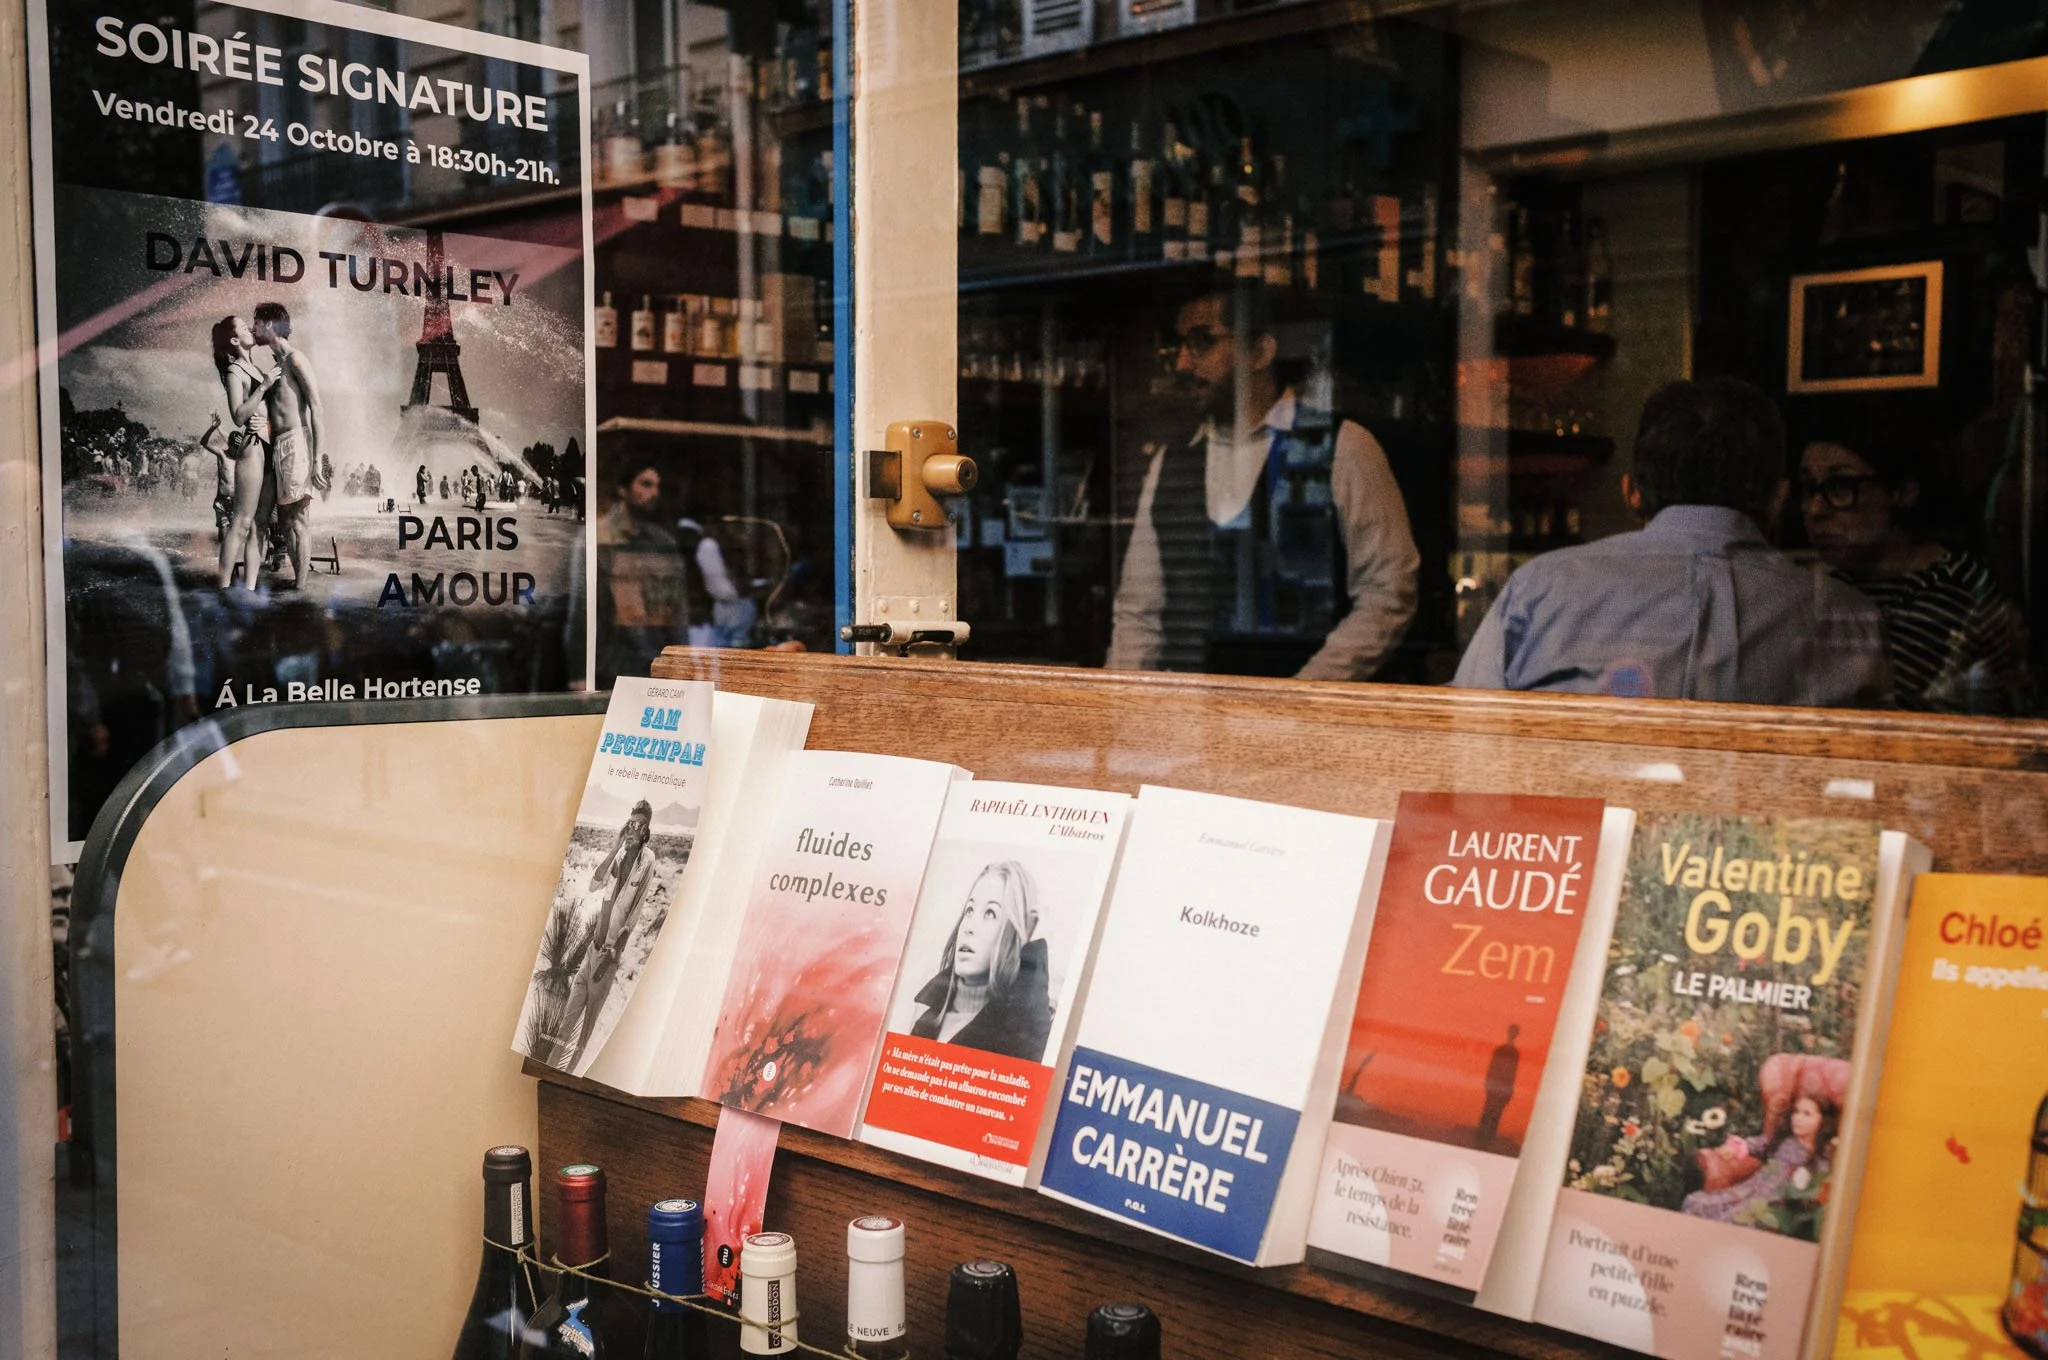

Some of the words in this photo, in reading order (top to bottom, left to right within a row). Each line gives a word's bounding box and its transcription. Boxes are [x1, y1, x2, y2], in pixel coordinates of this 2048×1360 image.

[95, 16, 284, 86] SOIRÉE
[298, 53, 549, 133] SIGNATURE
[92, 89, 234, 136] Vendredi
[243, 115, 279, 142] 24
[287, 123, 399, 161] Octobre
[406, 138, 421, 165] à
[428, 143, 560, 186] 18:30h-21h.
[146, 232, 305, 284] DAVID
[319, 251, 520, 306] TURNLEY
[398, 516, 519, 551] PARIS
[377, 572, 536, 608] AMOUR
[215, 679, 238, 708] Á
[247, 684, 277, 705] La
[288, 679, 355, 702] Belle
[364, 677, 481, 699] Hortense
[640, 706, 682, 731] SAM
[600, 733, 706, 766] PECKINPAH
[608, 766, 615, 775] le
[616, 767, 639, 779] rebelle
[640, 770, 686, 789] mélancolique
[970, 799, 1029, 816] RAPHAËL
[1031, 804, 1111, 824] ENTHOVEN
[796, 828, 873, 861] fluides
[1448, 829, 1582, 865] LAURENT
[1423, 861, 1582, 915] GAUDÉ
[1662, 842, 1862, 900] Valentine
[770, 872, 887, 907] complexes
[1180, 905, 1260, 938] Kolkhoze
[1685, 890, 1855, 986] Goby
[1940, 911, 2043, 950] Chloé
[1441, 924, 1555, 984] Zem
[1673, 971, 1706, 996] LE
[1707, 974, 1811, 1010] PALMIER
[882, 1062, 892, 1074] On
[900, 1066, 930, 1083] demande
[929, 1075, 942, 1087] pas
[948, 1081, 957, 1090] un
[958, 1080, 987, 1098] albatros
[987, 1090, 1027, 1107] encombré
[940, 1059, 952, 1072] pas
[972, 1066, 990, 1080] pour
[990, 1068, 997, 1081] la
[998, 1072, 1031, 1089] maladie.
[882, 1082, 893, 1093] par
[893, 1083, 904, 1093] ses
[904, 1084, 920, 1098] ailes
[920, 1087, 929, 1100] de
[929, 1091, 965, 1110] combattre
[965, 1103, 975, 1113] un
[976, 1104, 1006, 1120] taureau.
[1068, 1064, 1268, 1164] EMMANUEL
[1072, 1125, 1235, 1214] CARRÈRE
[1371, 1165, 1407, 1187] Chien
[1334, 1180, 1347, 1198] le
[1348, 1186, 1386, 1210] temps
[1389, 1193, 1405, 1211] de
[1407, 1196, 1420, 1215] la
[1568, 1229, 1629, 1258] Portrait
[652, 1242, 660, 1308] JUSSIER
[1590, 1261, 1638, 1284] petite
[1639, 1271, 1675, 1294] fille
[1588, 1286, 1608, 1301] en
[857, 1327, 889, 1337] NEUVE
